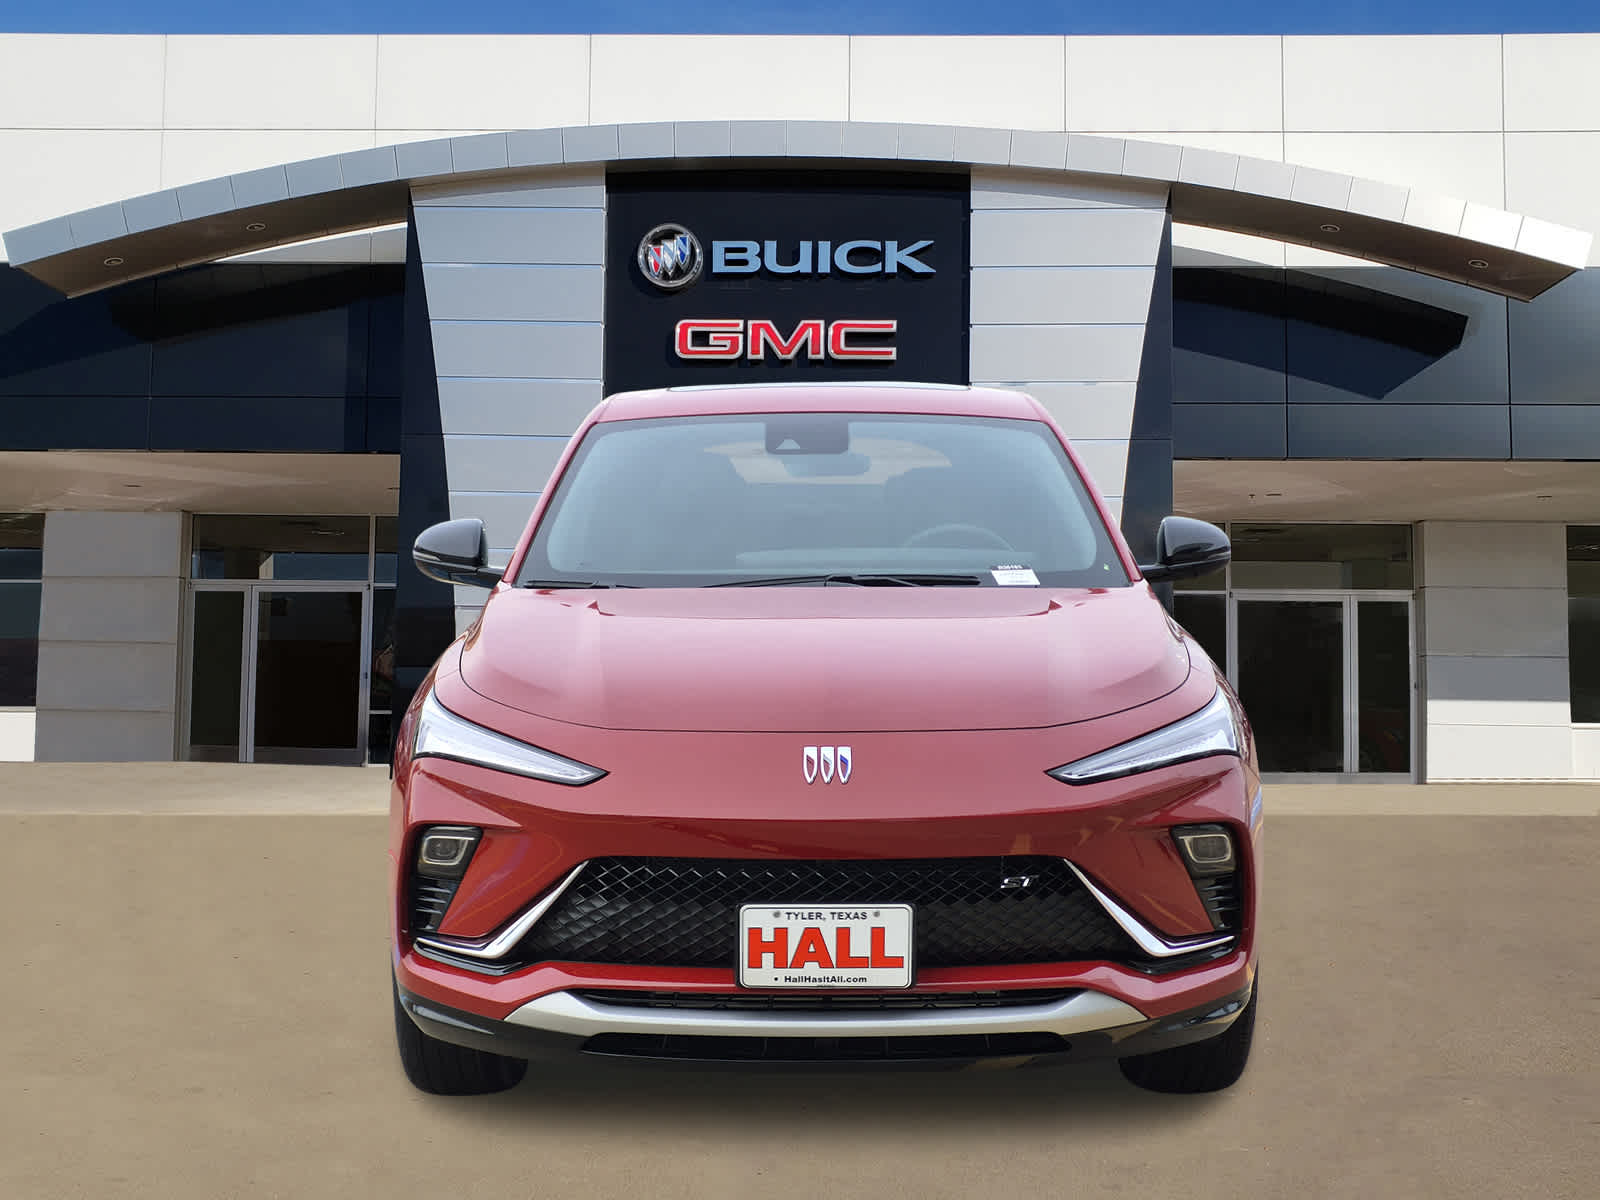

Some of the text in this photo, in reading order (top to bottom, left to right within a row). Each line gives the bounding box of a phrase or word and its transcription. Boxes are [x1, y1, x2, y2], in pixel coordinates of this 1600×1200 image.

[712, 240, 936, 273] BUICK
[674, 318, 897, 360] GMC
[785, 910, 868, 921] TYLER, TEXAS
[747, 926, 905, 969] HALL
[784, 975, 868, 983] HallHasItAll.com
